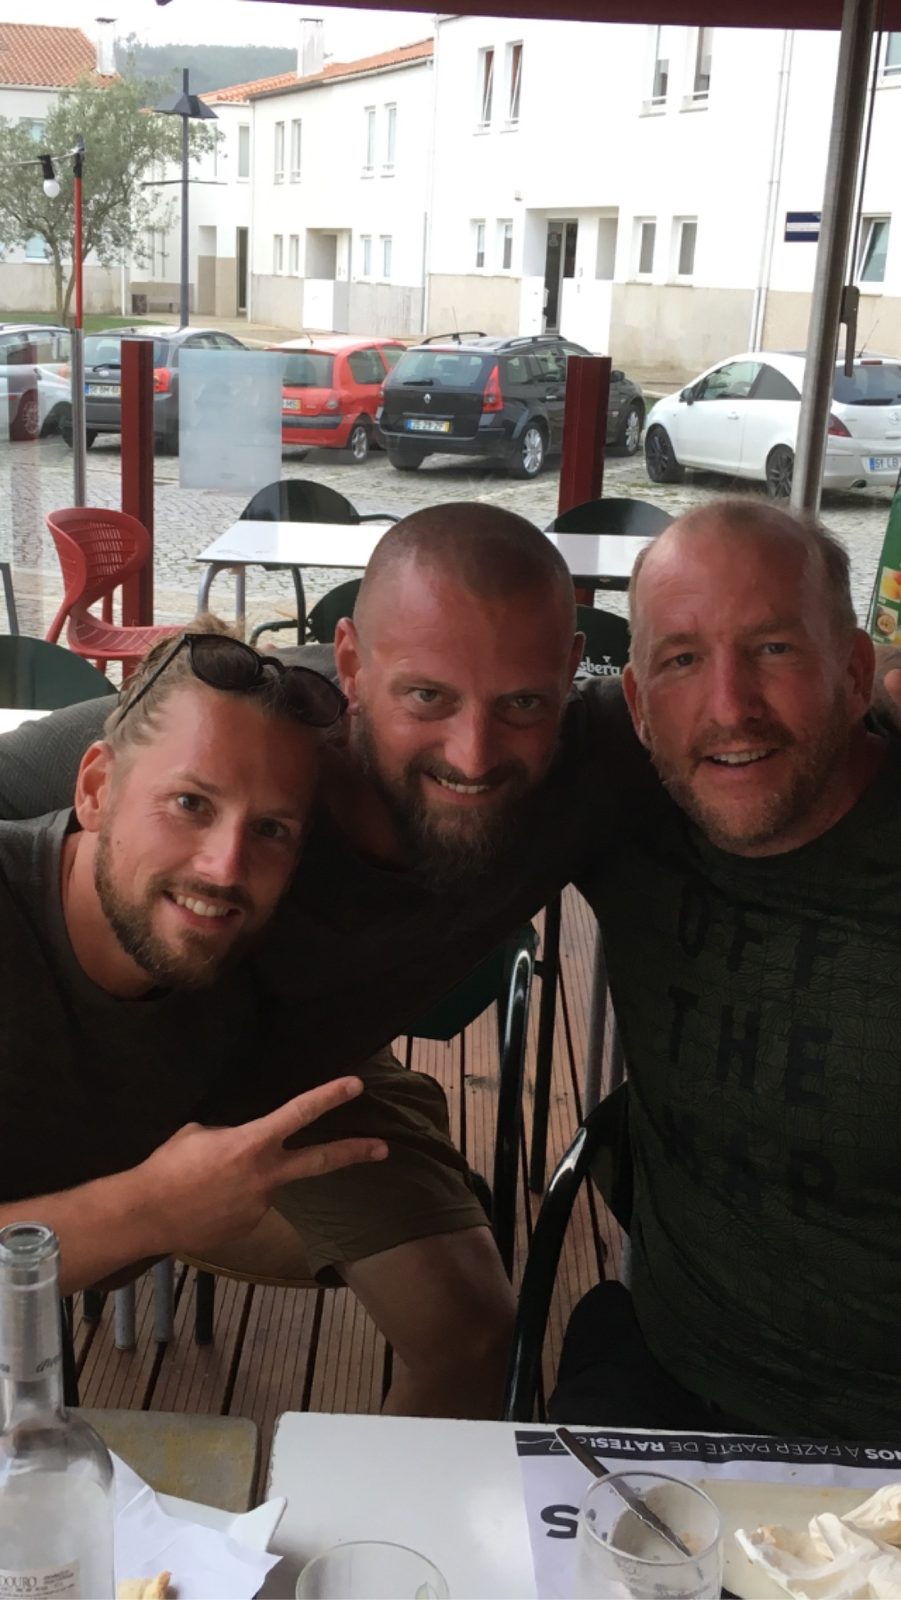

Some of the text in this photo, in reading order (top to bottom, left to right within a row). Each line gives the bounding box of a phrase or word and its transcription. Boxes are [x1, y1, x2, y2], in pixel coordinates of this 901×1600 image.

[576, 656, 620, 676] sberg
[677, 879, 842, 988] OFF
[667, 984, 832, 1105] THE
[663, 1104, 838, 1216] MAP
[590, 1437, 666, 1453] RATES!
[669, 1441, 699, 1453] DE
[704, 1442, 771, 1455] PARTE
[776, 1442, 841, 1456] FAZER
